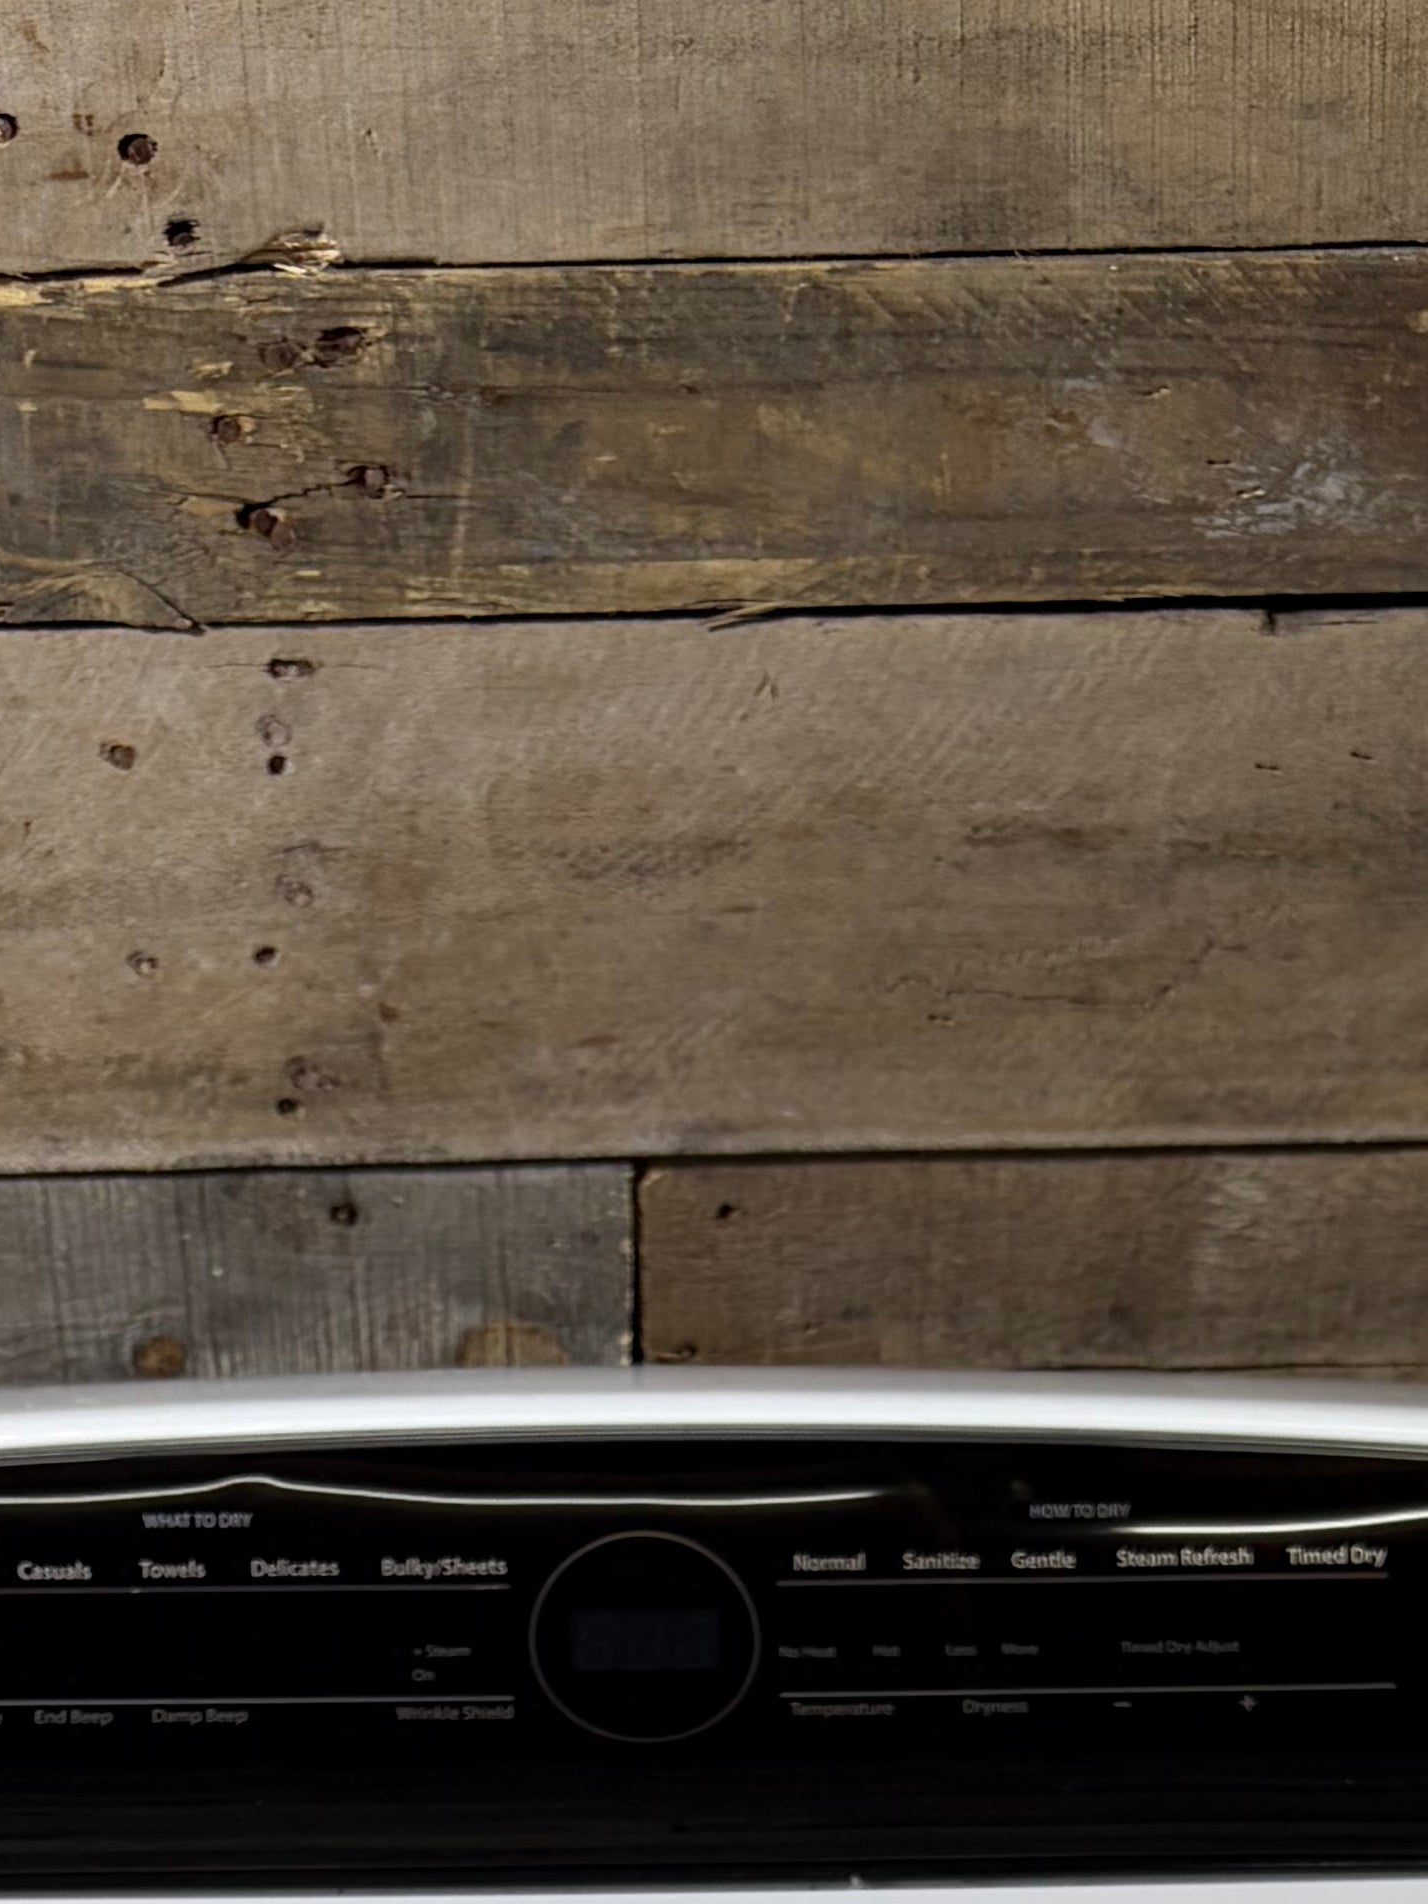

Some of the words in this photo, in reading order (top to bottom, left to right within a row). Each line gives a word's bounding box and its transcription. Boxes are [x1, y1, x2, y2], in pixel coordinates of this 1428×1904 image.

[142, 1512, 192, 1529] WHAT
[193, 1512, 217, 1529] TO
[218, 1512, 254, 1529] DRY
[1028, 1502, 1072, 1519] HOW
[1073, 1502, 1095, 1519] TO
[1096, 1502, 1133, 1519] DRY
[792, 1549, 867, 1572] Normal
[902, 1548, 982, 1570] Sanitize
[1010, 1547, 1078, 1570] Gentle
[1115, 1546, 1179, 1568] Steam
[1180, 1545, 1256, 1567] Refresh
[1285, 1543, 1348, 1566] Timed
[1349, 1542, 1389, 1569] Dry
[16, 1559, 93, 1581] Casuals
[137, 1556, 207, 1579] Towels
[250, 1557, 340, 1578] Delicates
[380, 1555, 509, 1580] Bulky/Sheets
[1165, 1640, 1192, 1656] Dry
[33, 1709, 68, 1725] End
[69, 1709, 114, 1727] Beep
[204, 1708, 249, 1726] Beep
[788, 1701, 897, 1718] Temperature
[961, 1698, 1031, 1717] Dryness
